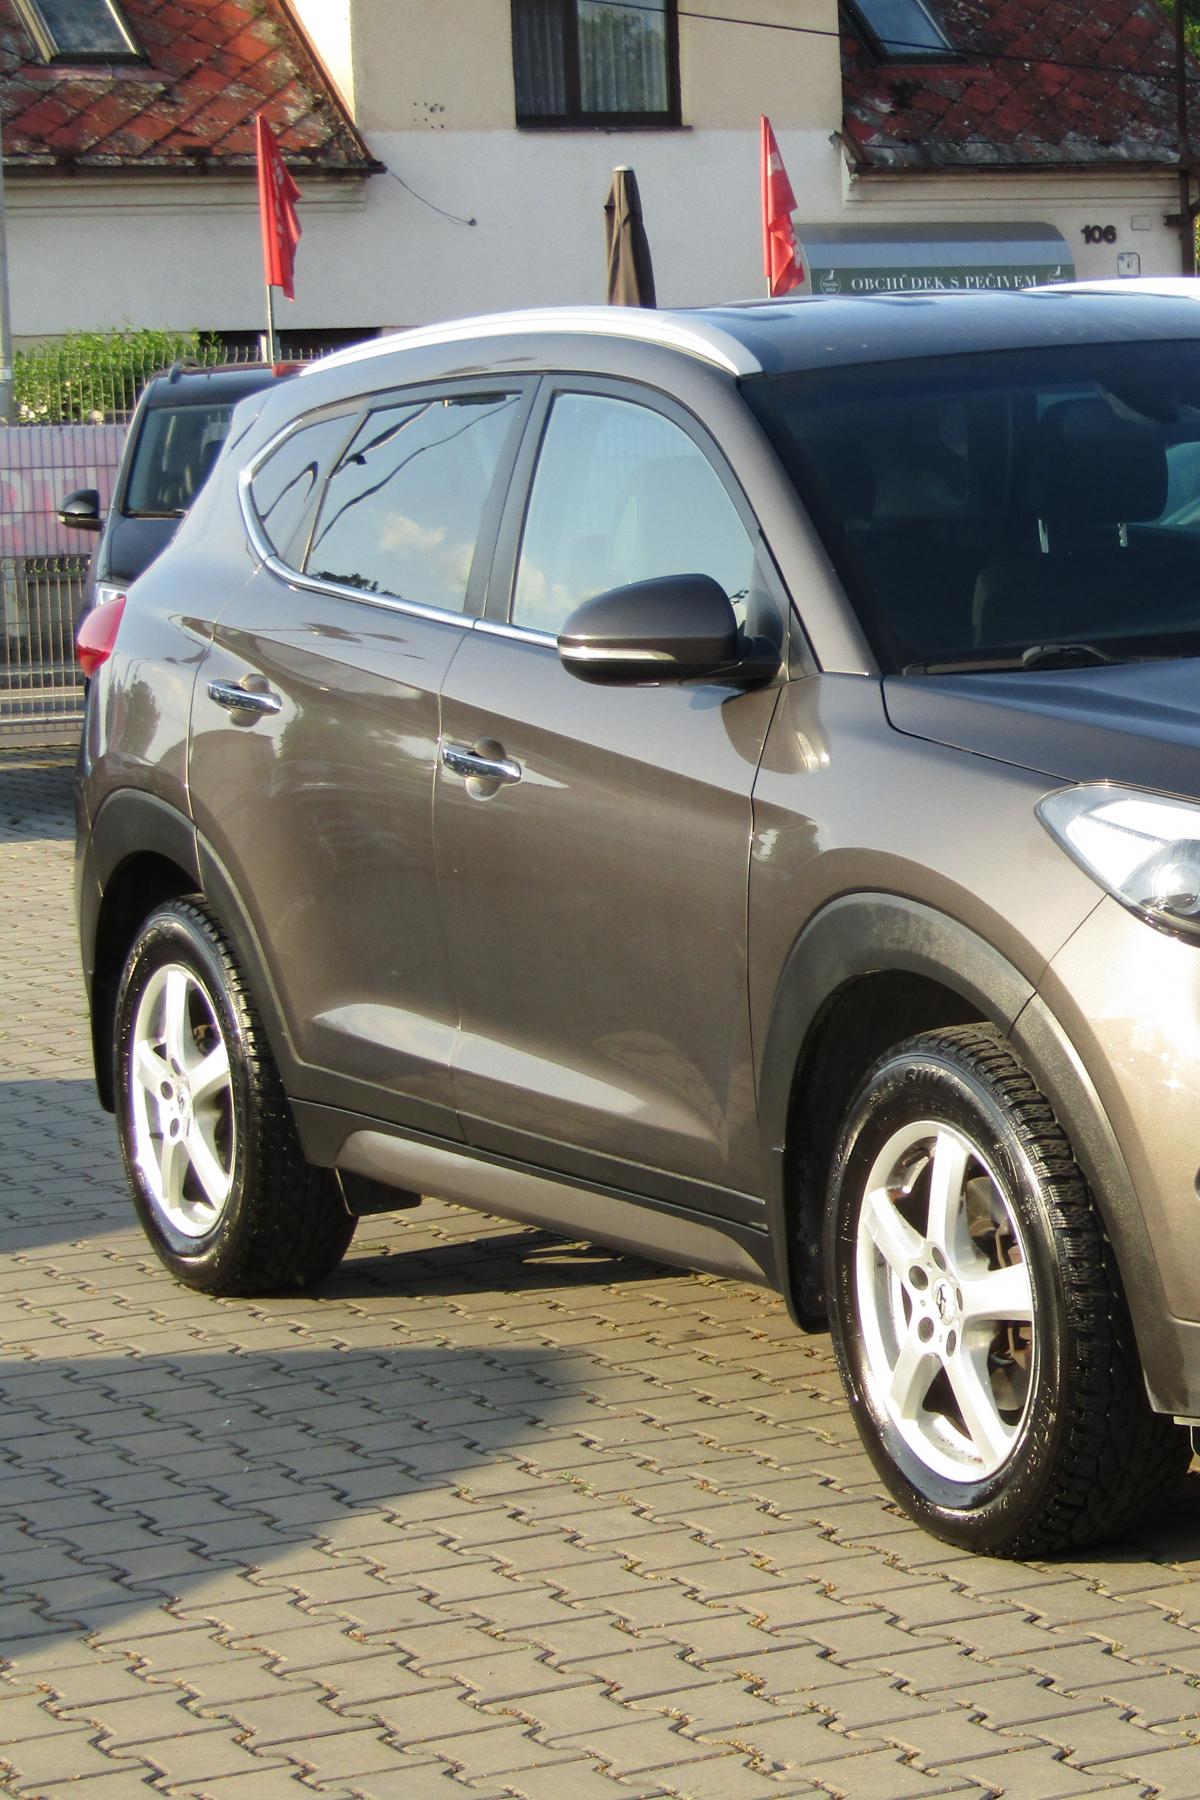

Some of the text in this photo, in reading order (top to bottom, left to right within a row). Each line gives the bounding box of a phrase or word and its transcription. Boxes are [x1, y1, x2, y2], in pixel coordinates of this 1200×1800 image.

[1081, 225, 1117, 244] 106
[950, 276, 960, 289] S
[965, 273, 1037, 289] PEČIVEM
